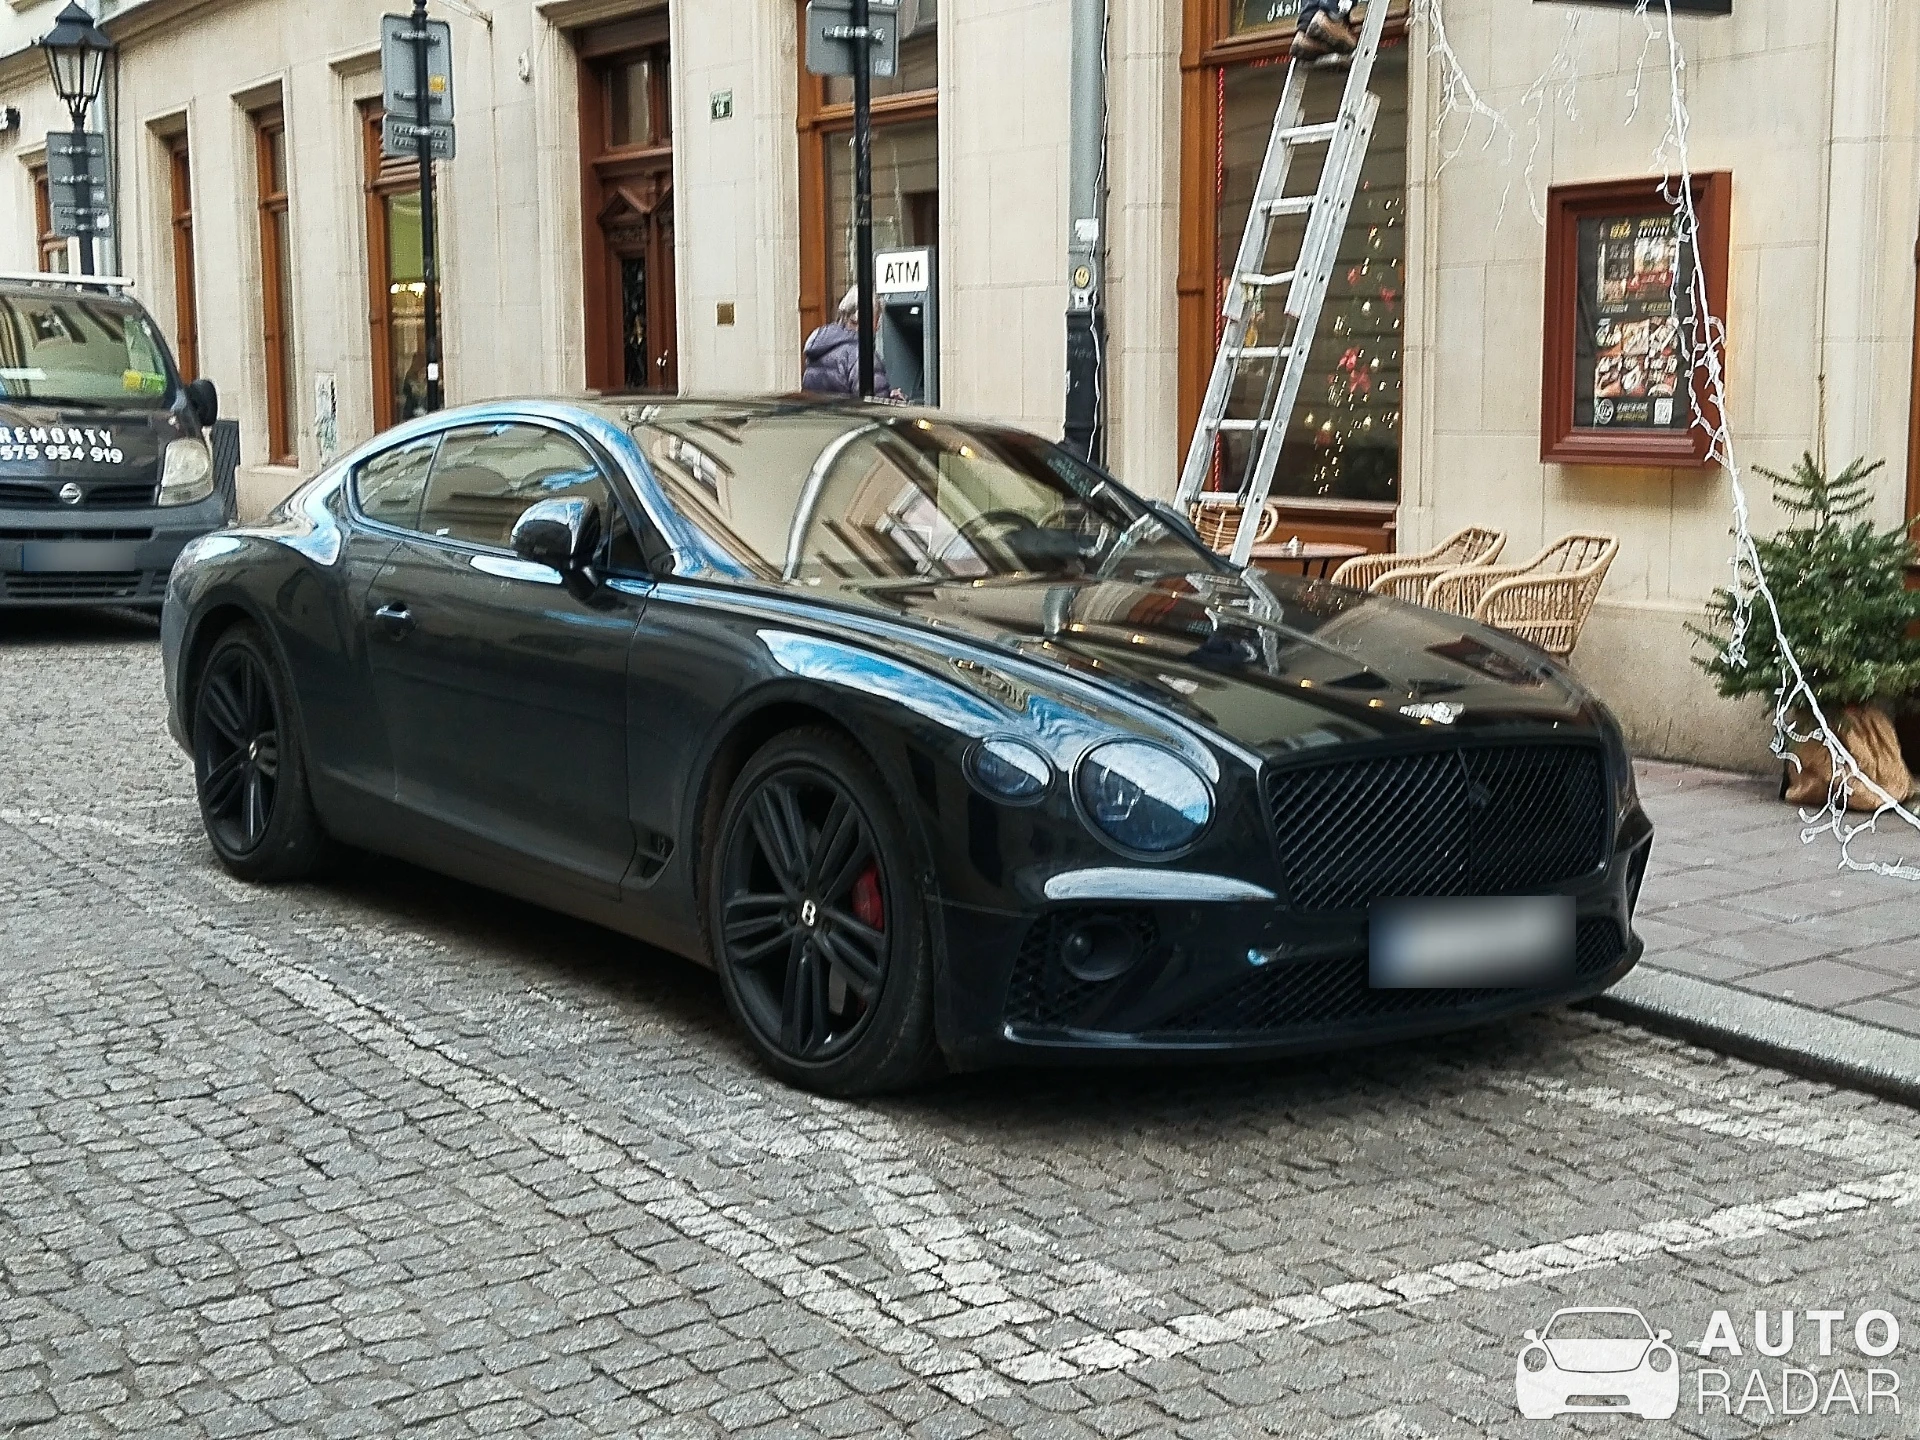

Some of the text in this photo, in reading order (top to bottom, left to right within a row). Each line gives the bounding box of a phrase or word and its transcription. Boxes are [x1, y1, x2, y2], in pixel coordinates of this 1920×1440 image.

[884, 260, 920, 284] ATM
[0, 427, 112, 446] REMONTY
[0, 445, 123, 463] 575 954 919
